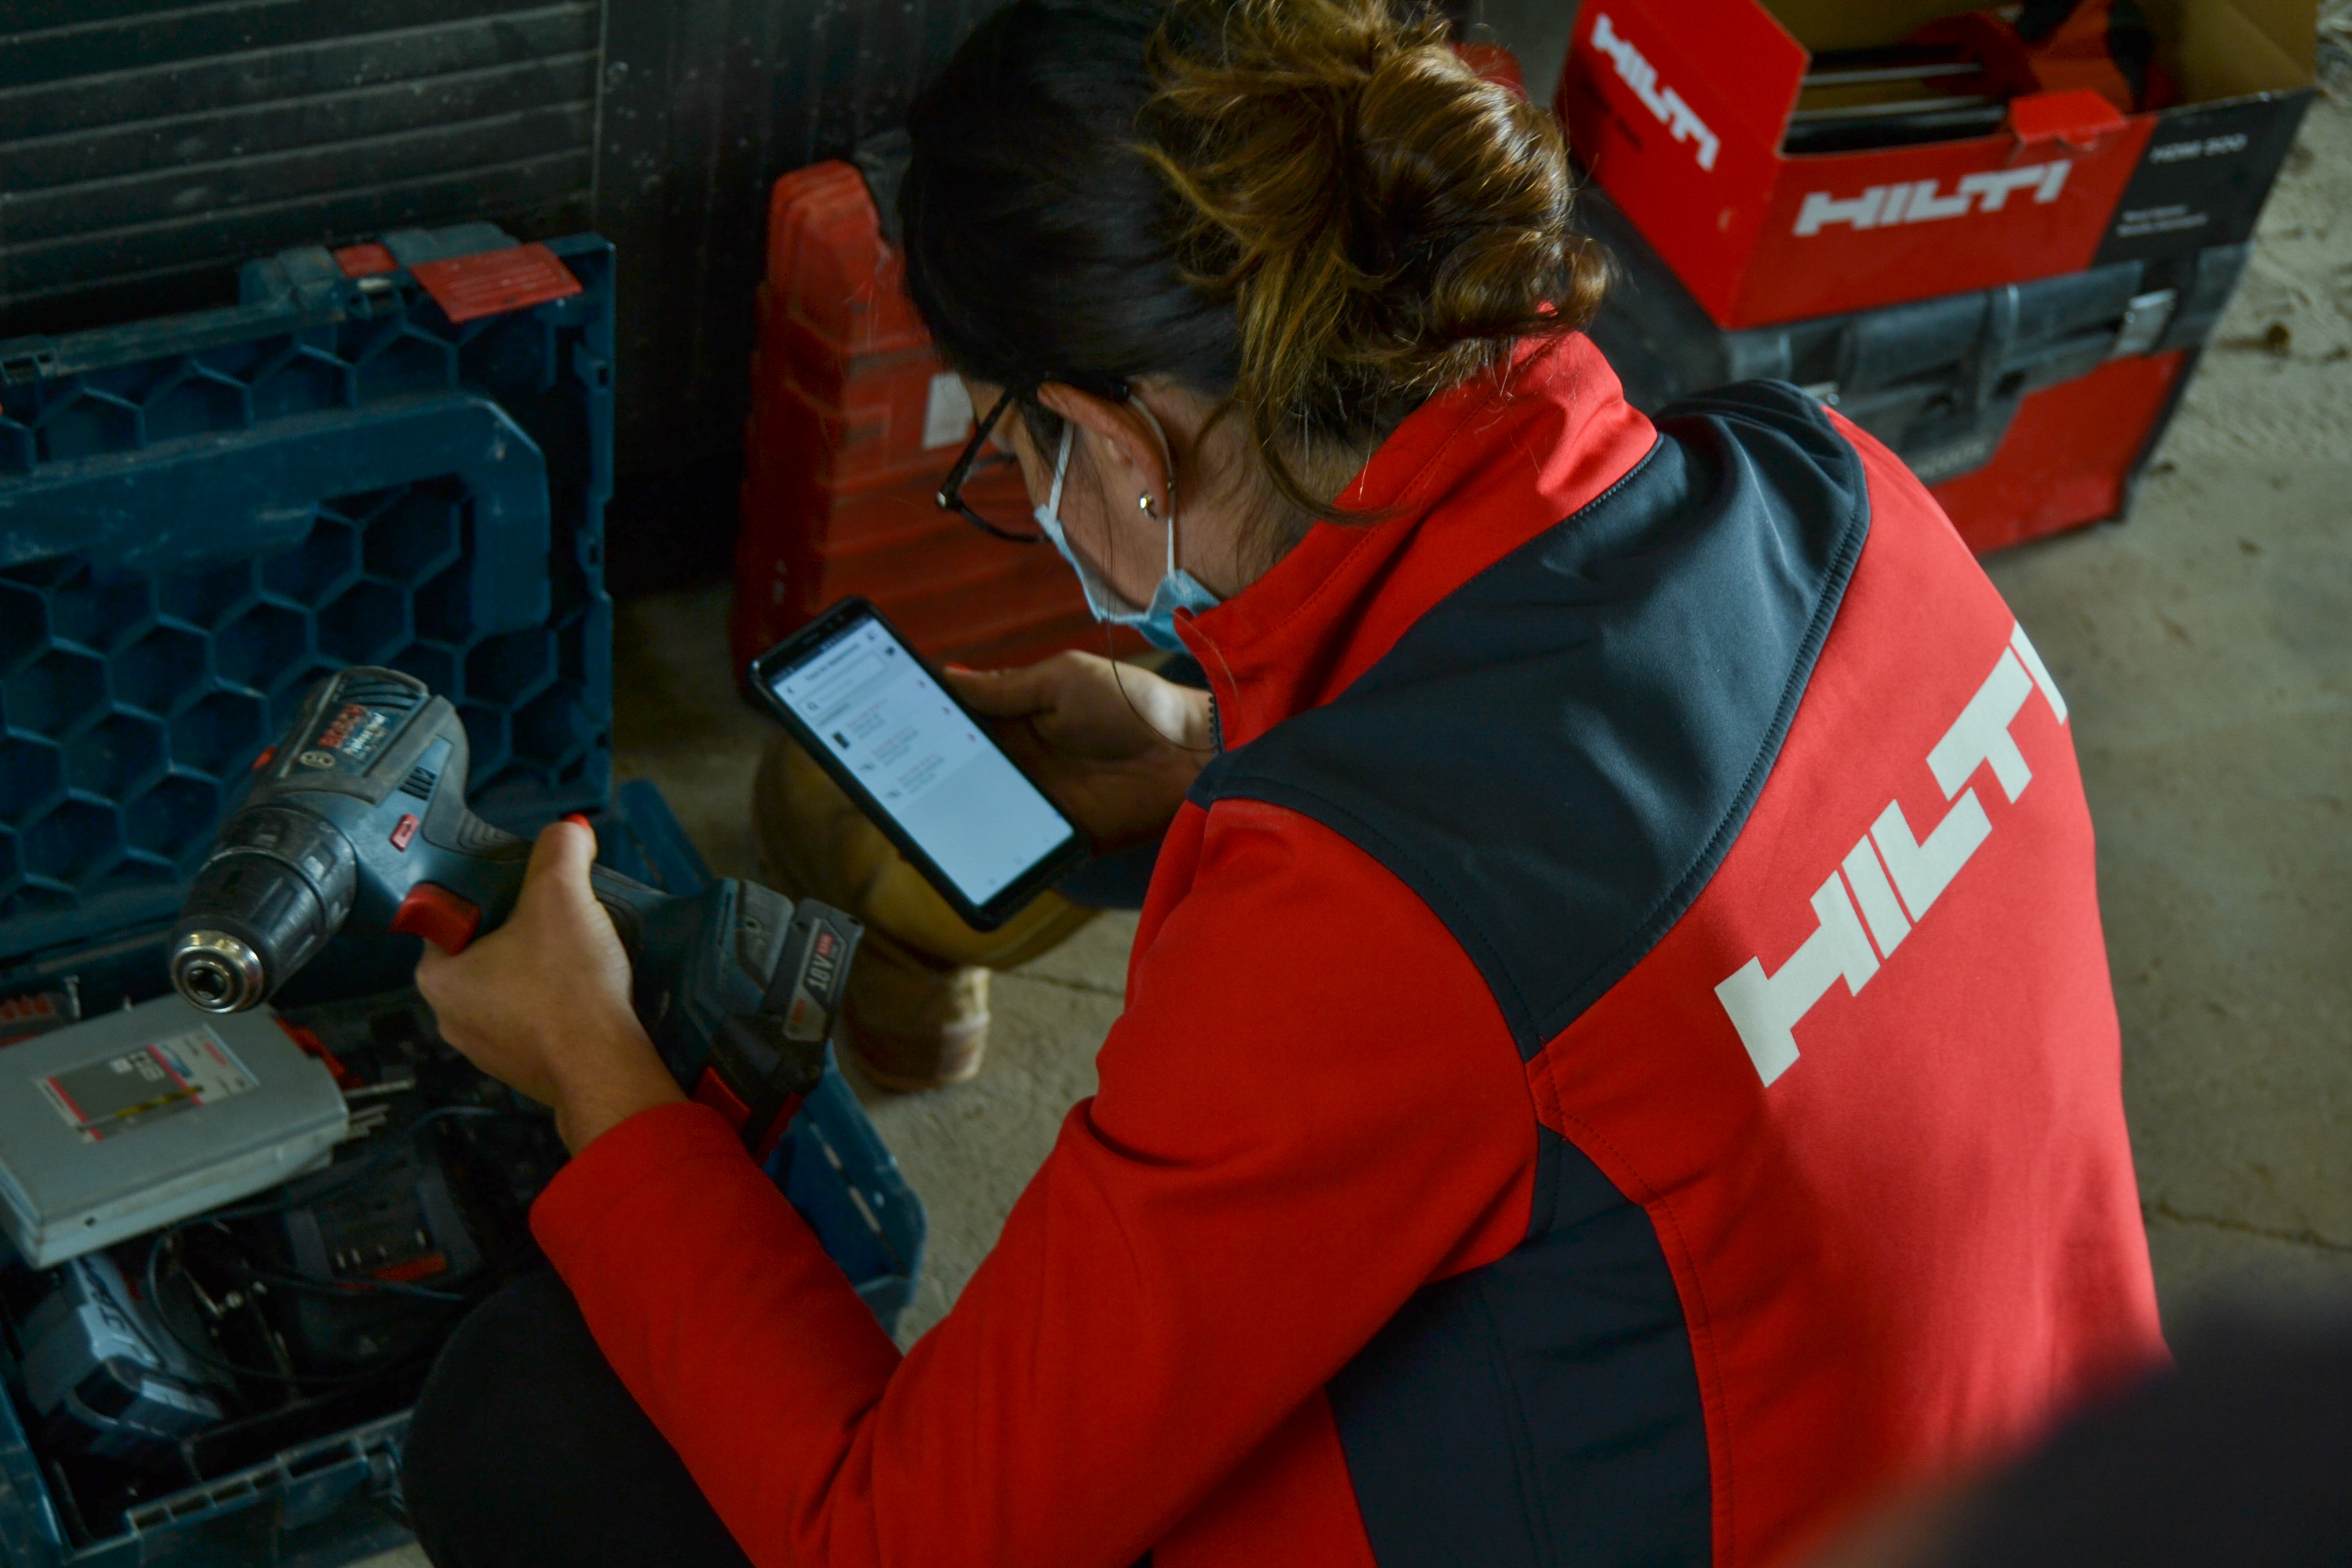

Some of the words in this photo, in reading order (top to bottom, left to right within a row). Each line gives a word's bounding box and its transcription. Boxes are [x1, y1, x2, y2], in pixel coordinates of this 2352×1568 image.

[1591, 12, 1720, 172] HILTI
[1793, 159, 2072, 237] HILTI
[1714, 620, 2068, 1088] HILTI
